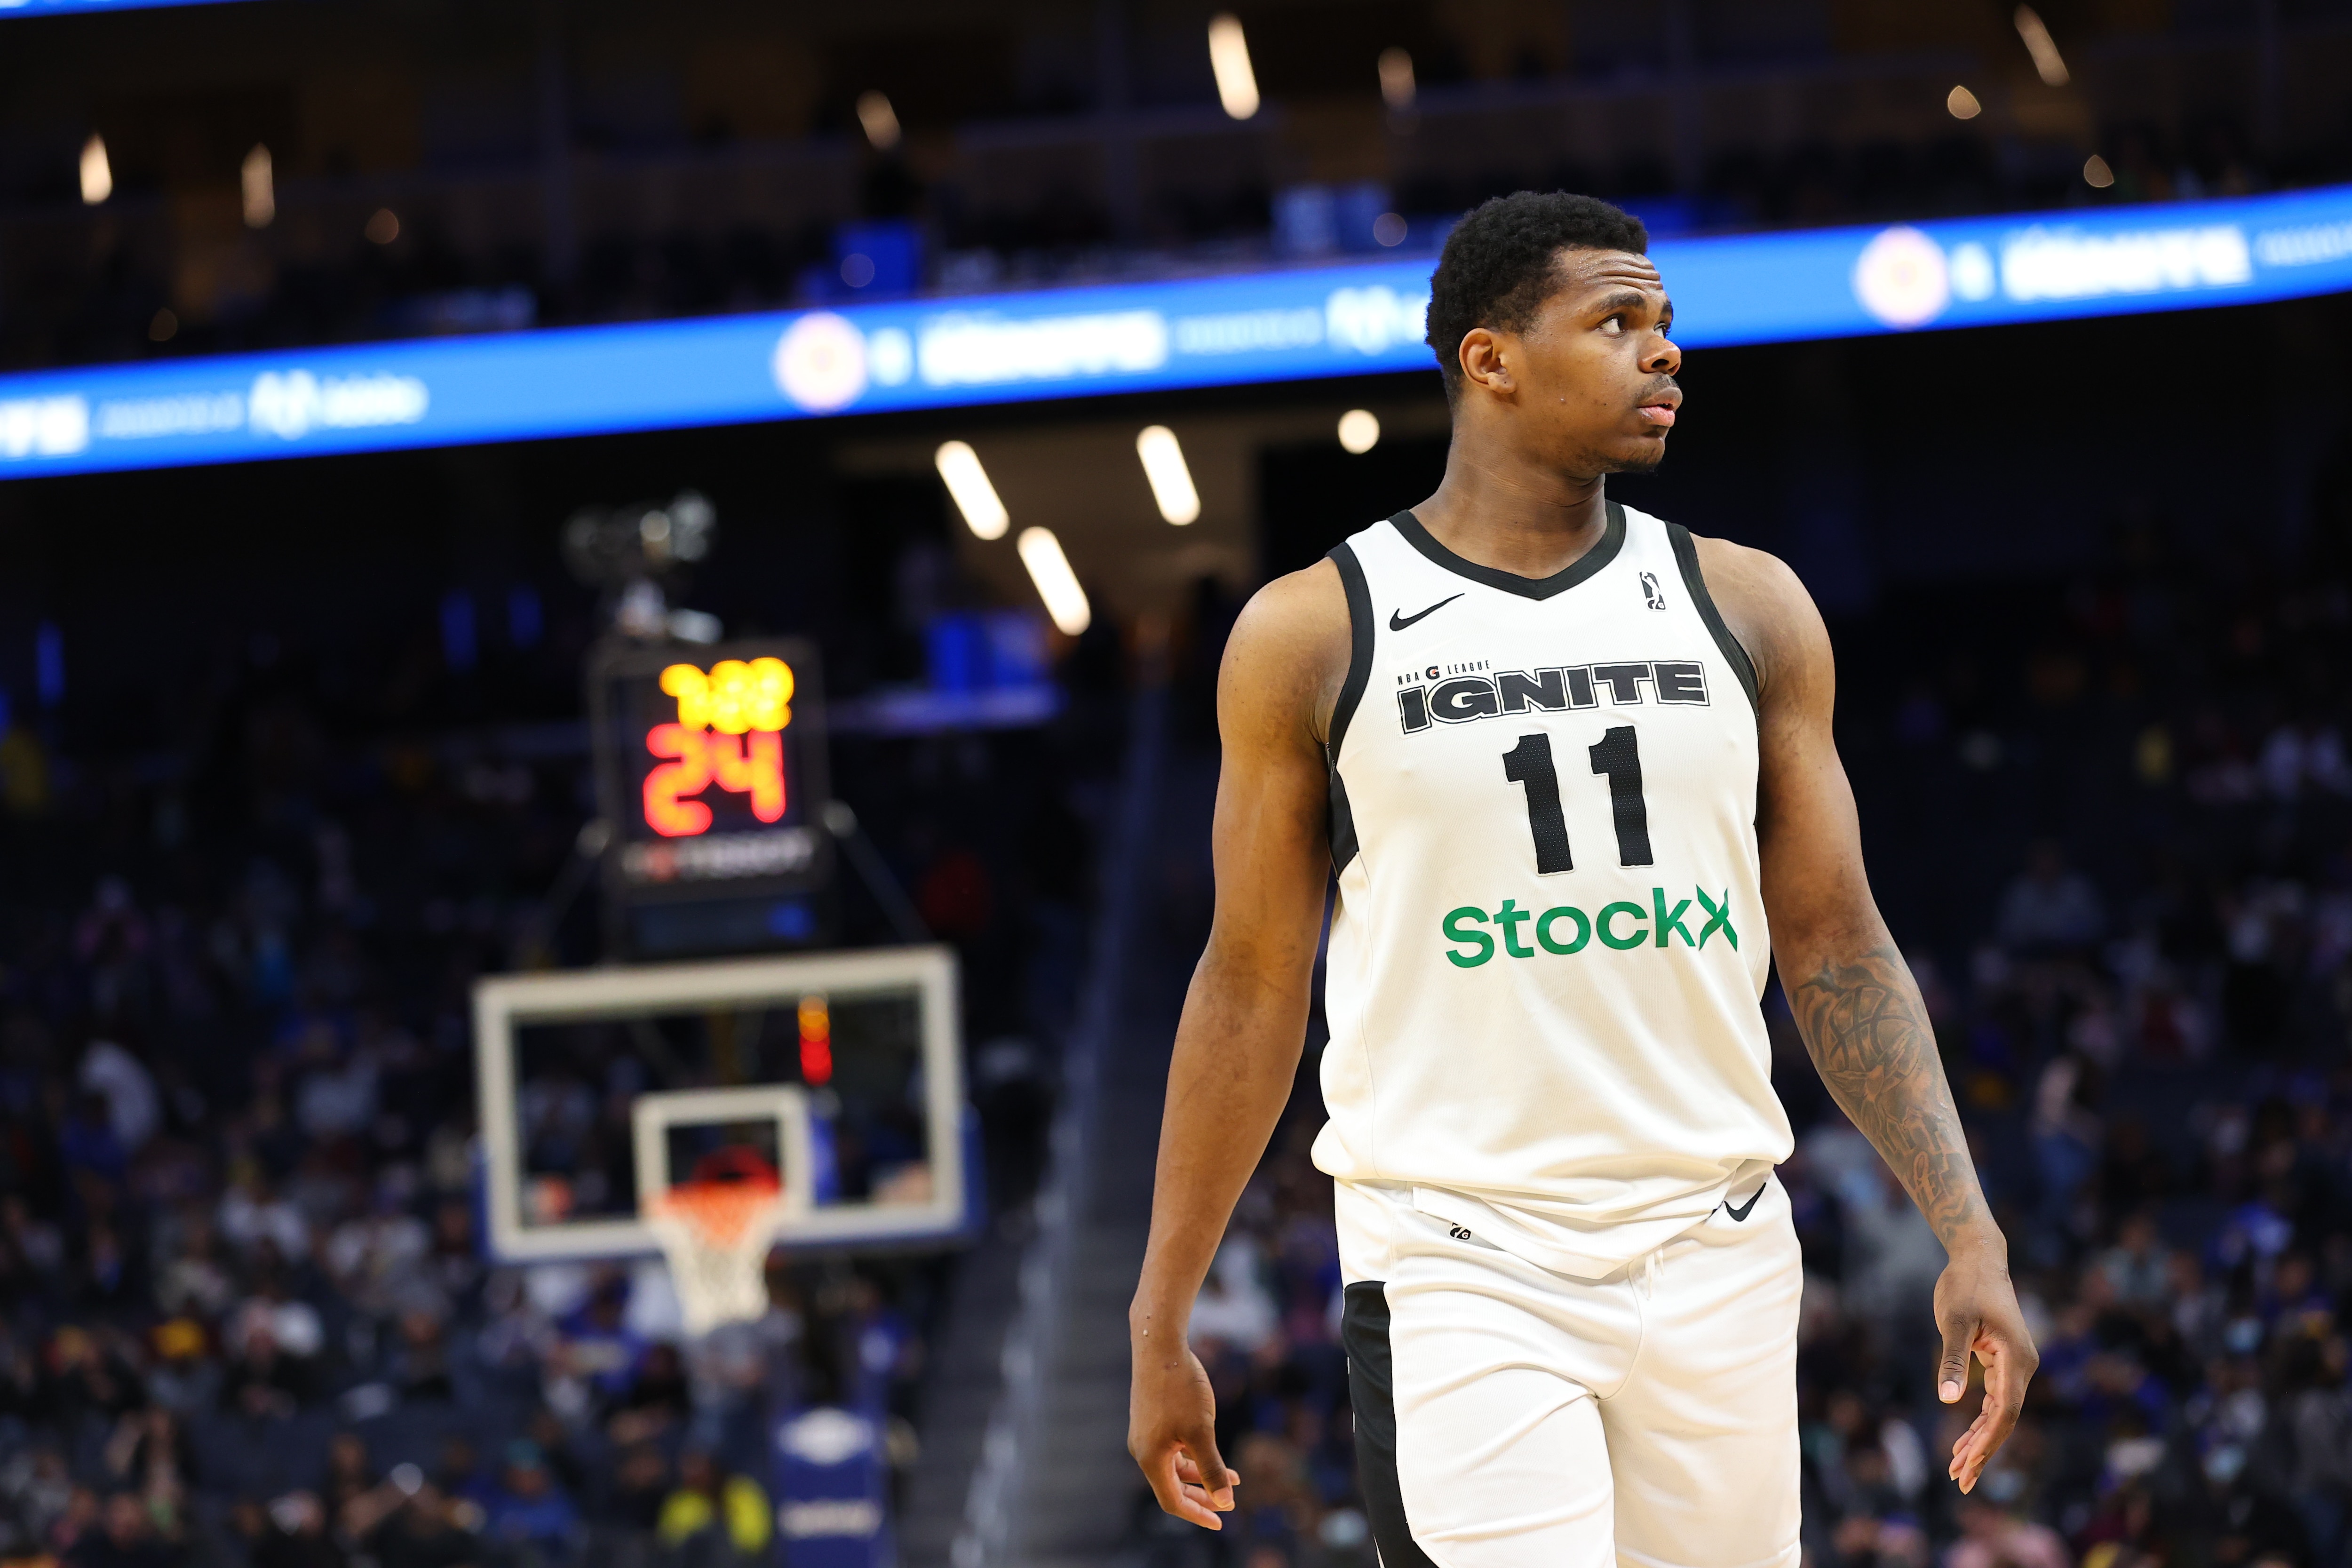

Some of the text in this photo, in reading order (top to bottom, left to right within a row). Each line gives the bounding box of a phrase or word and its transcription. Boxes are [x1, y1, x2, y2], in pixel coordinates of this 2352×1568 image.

[1397, 660, 1710, 735] IGNITE
[1398, 660, 1490, 685] NBA G LEAGUE
[644, 723, 786, 837] 24
[1502, 725, 1654, 875] 11
